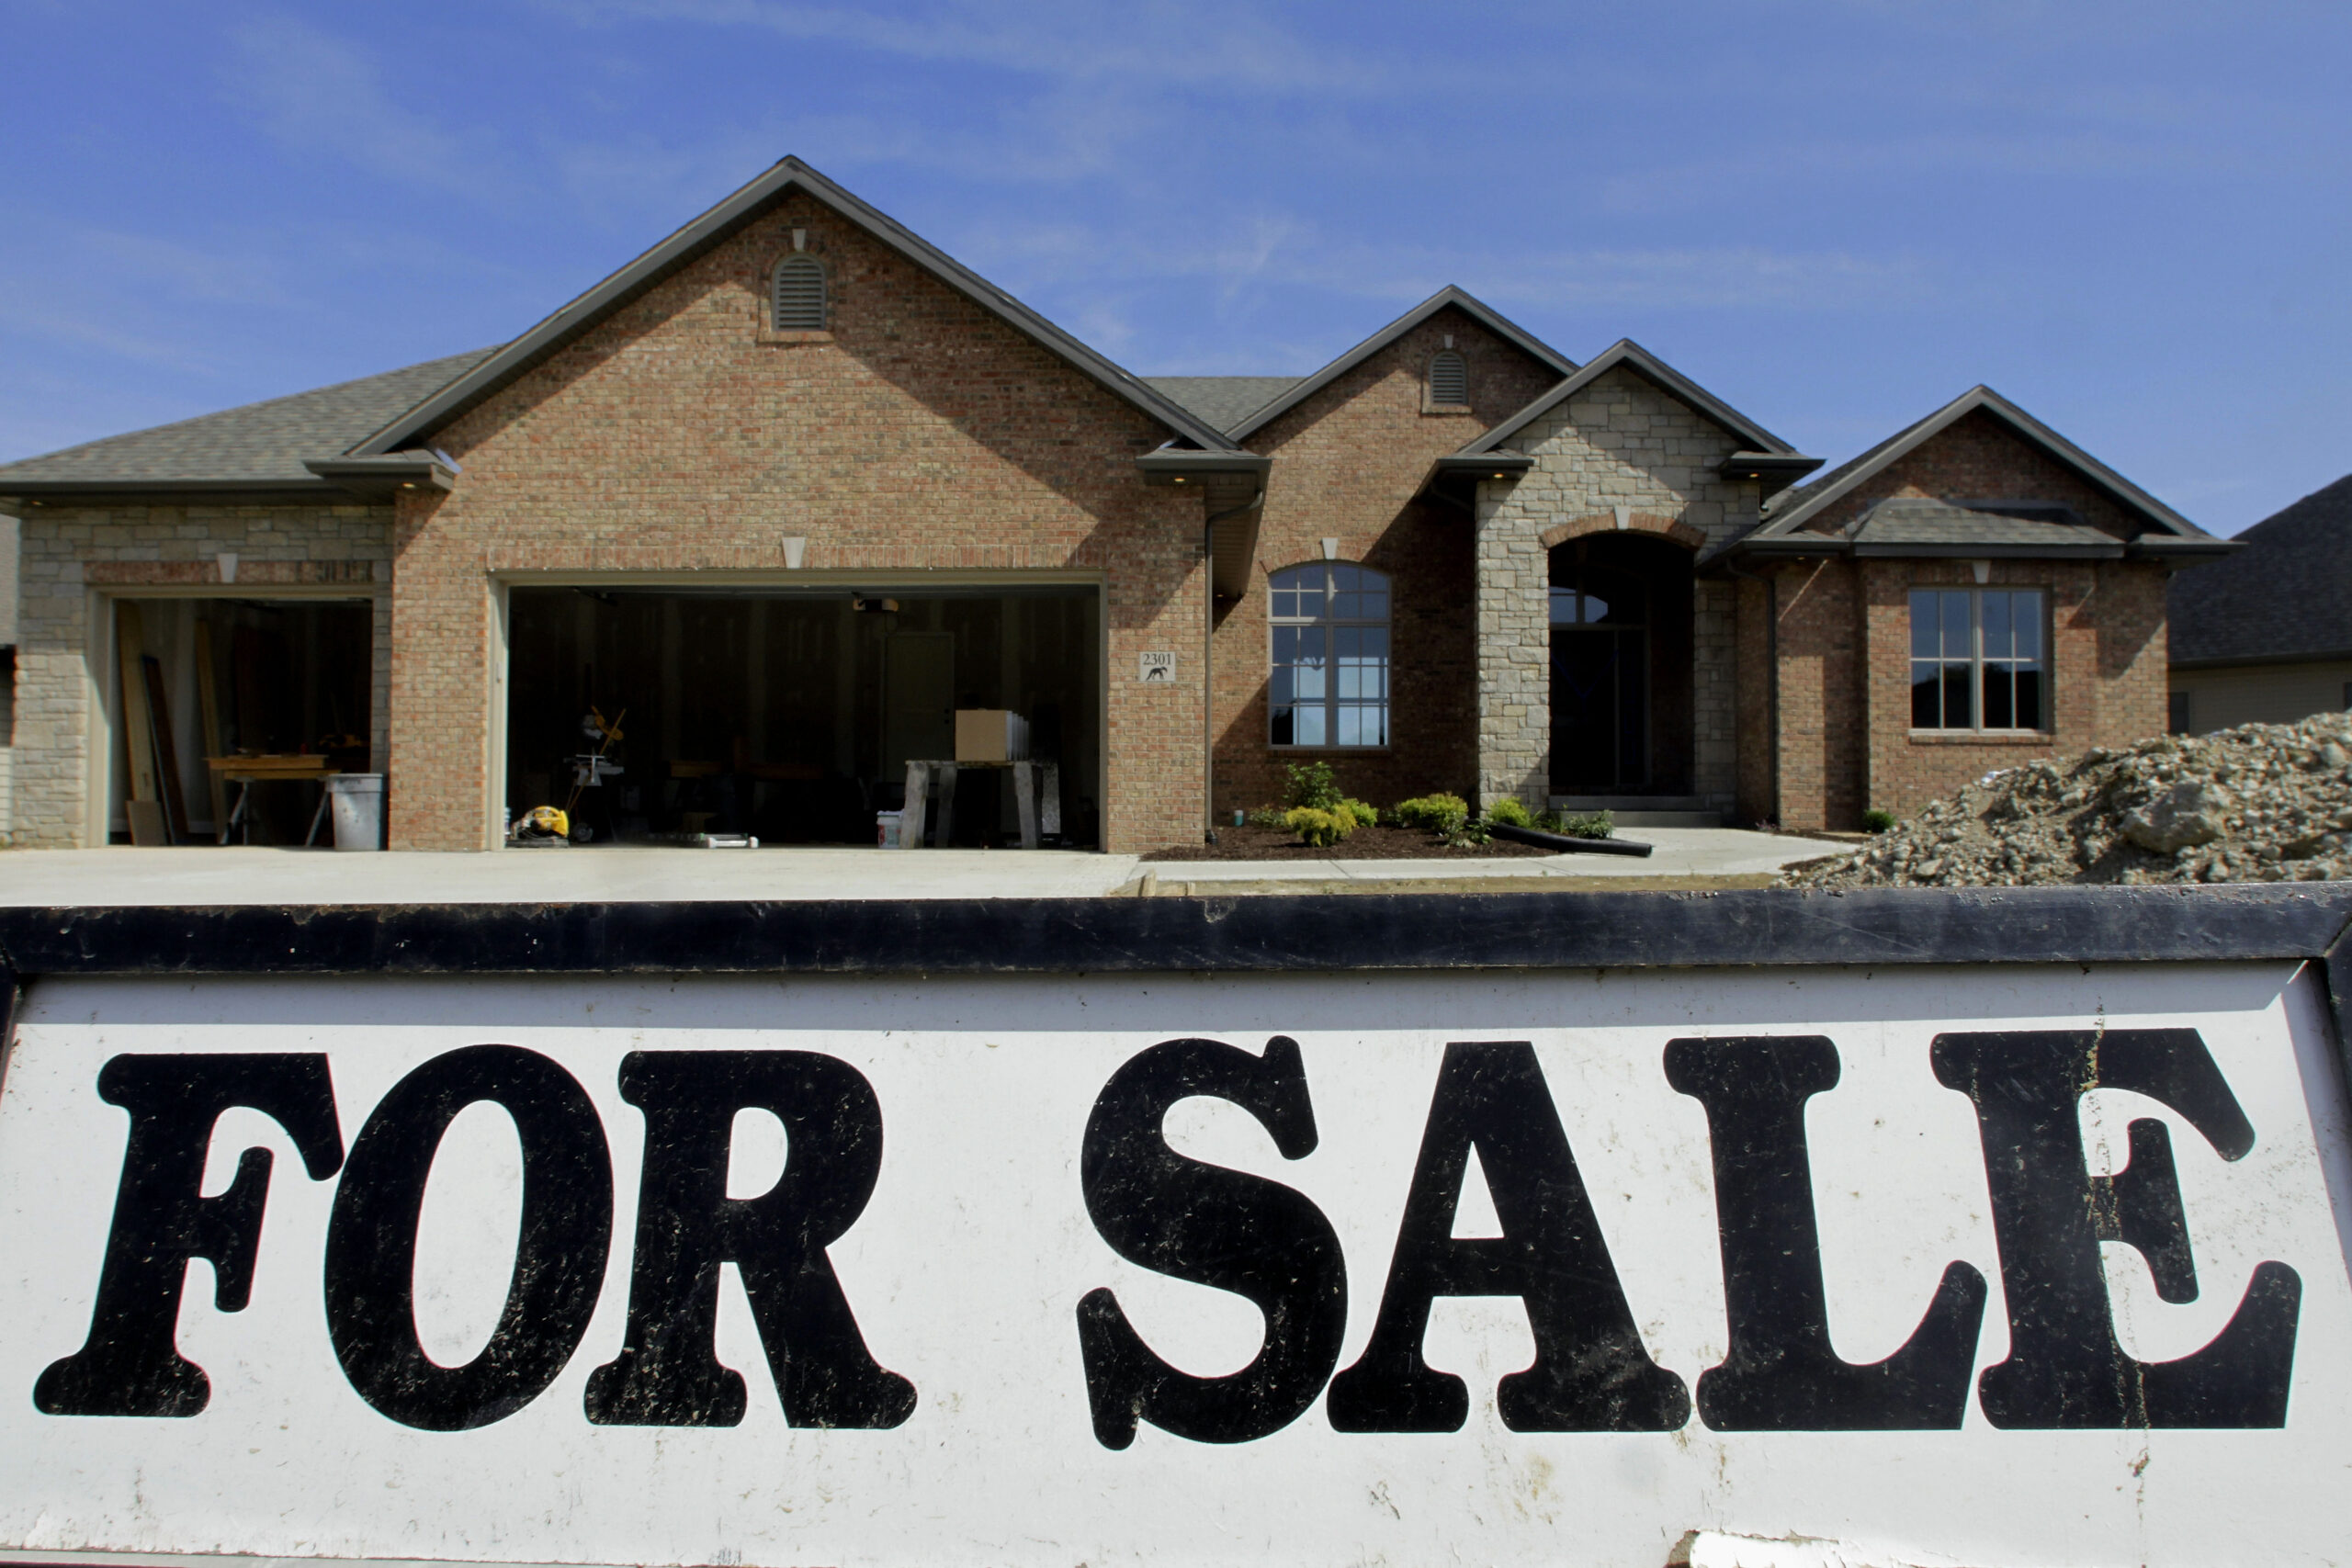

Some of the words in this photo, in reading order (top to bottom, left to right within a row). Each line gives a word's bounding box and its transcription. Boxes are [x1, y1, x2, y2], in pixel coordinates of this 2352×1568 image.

[1142, 653, 1171, 666] 2301
[33, 1044, 917, 1431] FOR
[1077, 1028, 2301, 1450] SALE
